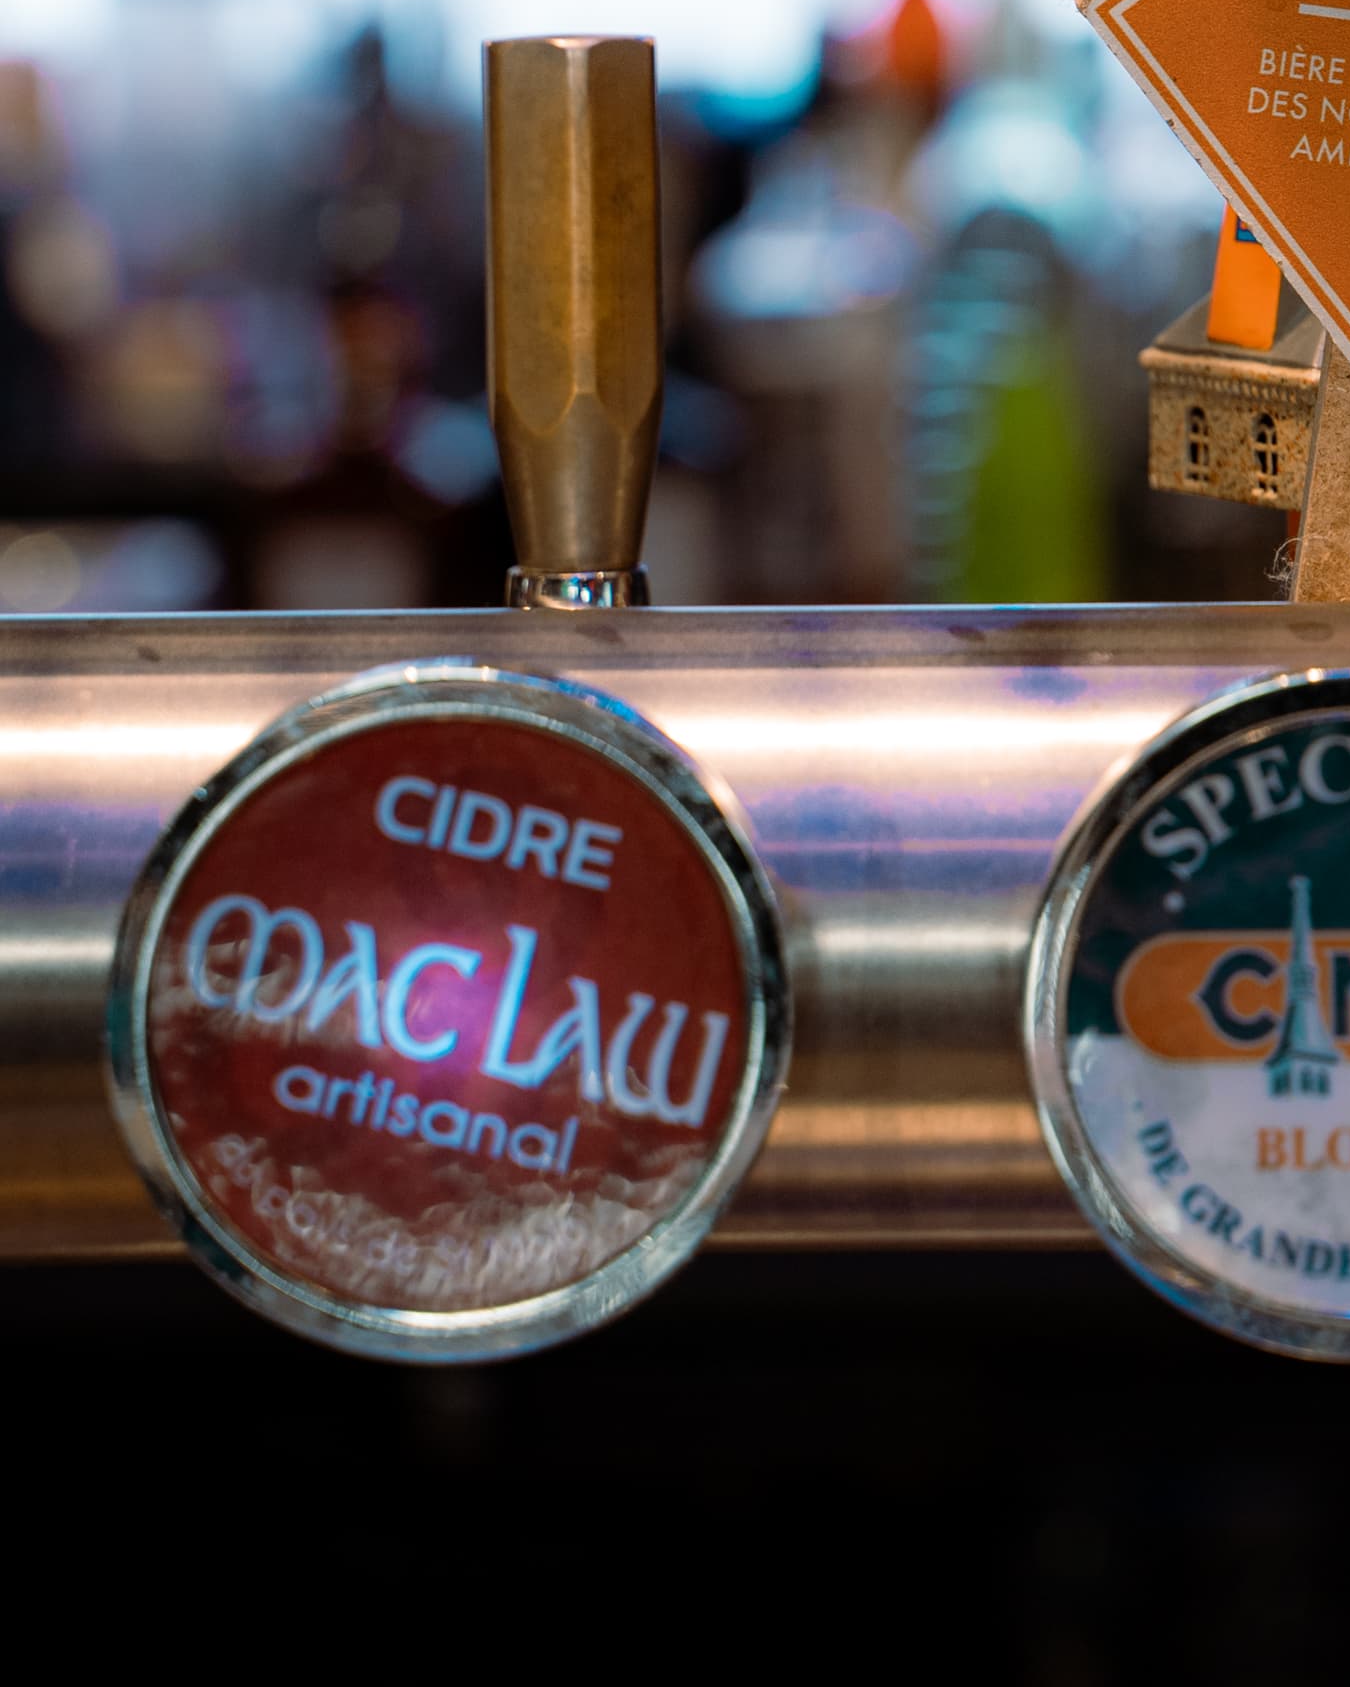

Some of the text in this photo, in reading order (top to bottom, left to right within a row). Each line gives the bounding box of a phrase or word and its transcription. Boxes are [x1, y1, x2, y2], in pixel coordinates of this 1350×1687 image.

[1259, 45, 1346, 85] BIÈRE
[1247, 86, 1308, 120] DES
[375, 775, 623, 891] CIDRE
[273, 1065, 579, 1175] artisanal
[1137, 1119, 1189, 1189] DE
